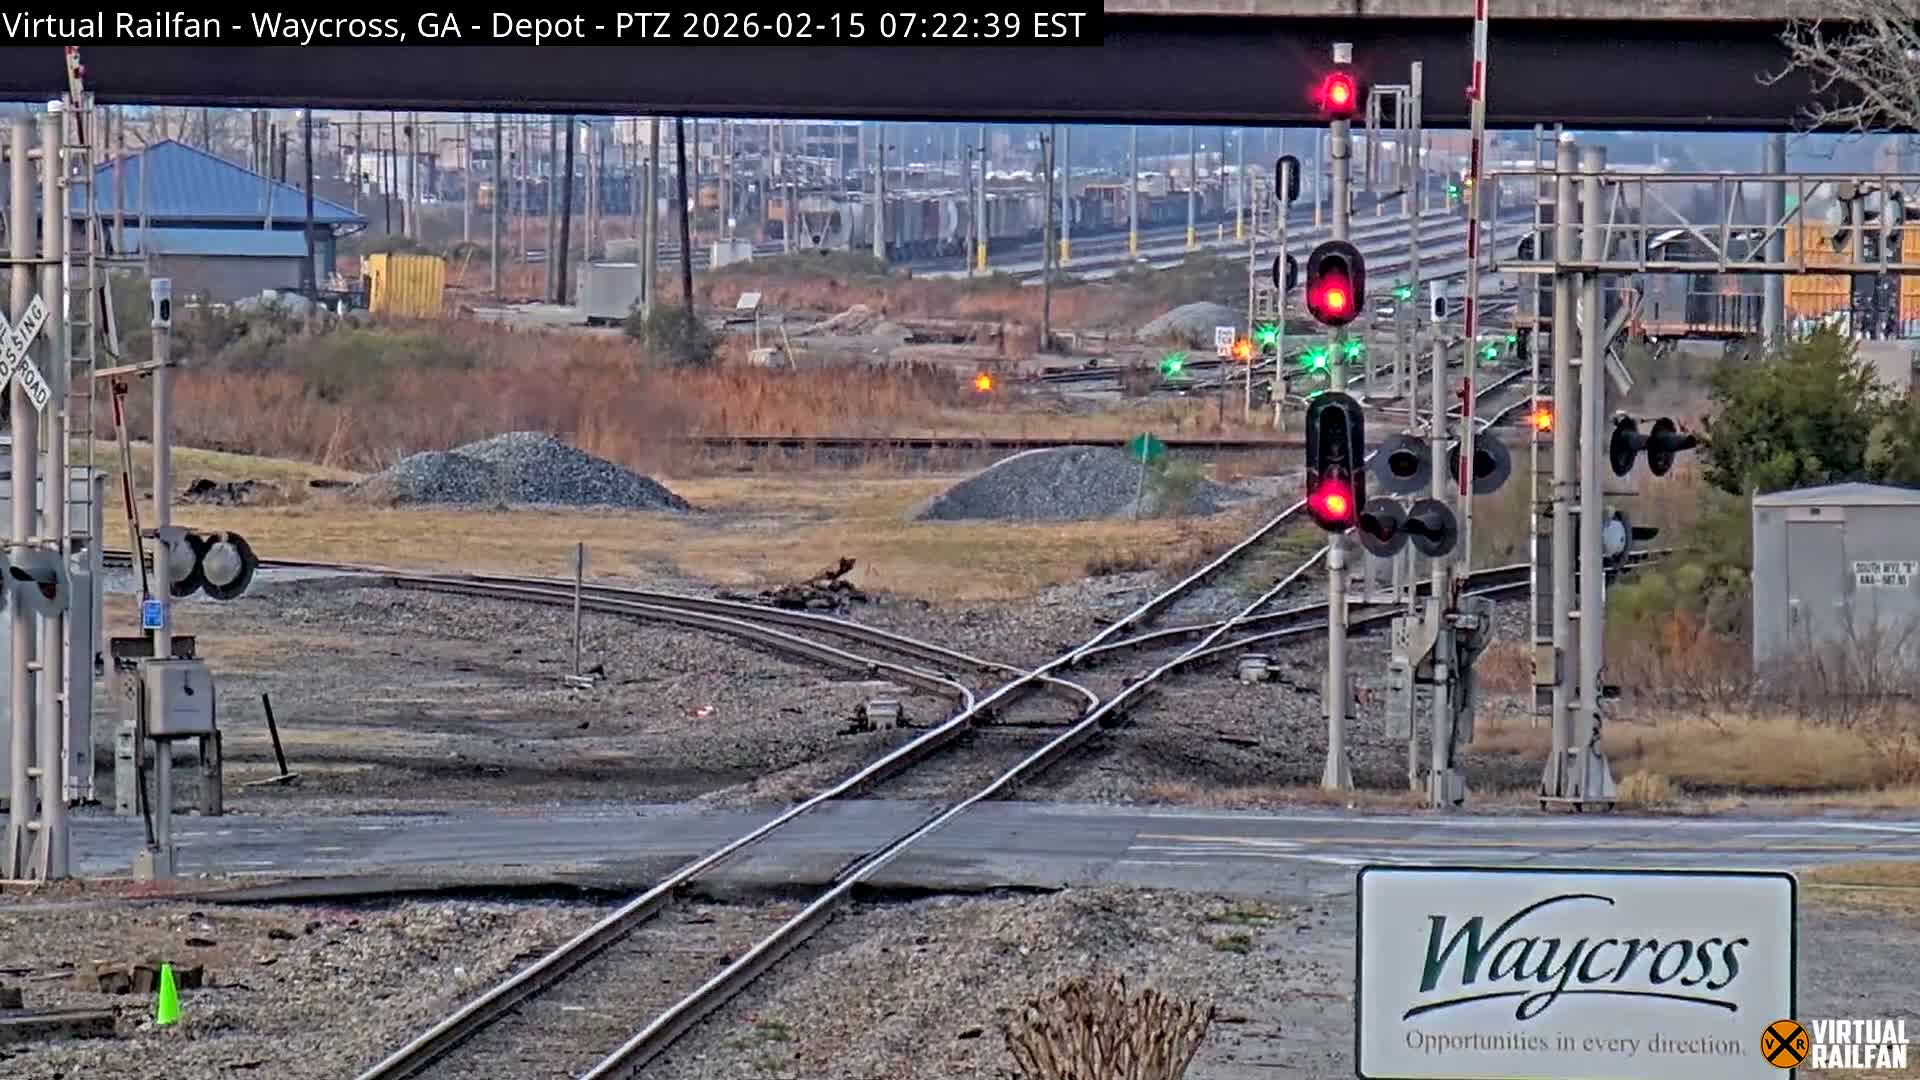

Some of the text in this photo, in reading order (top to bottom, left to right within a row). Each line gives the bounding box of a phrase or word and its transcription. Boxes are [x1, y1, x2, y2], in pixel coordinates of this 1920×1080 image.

[0, 304, 42, 386] OSSING
[20, 359, 47, 404] ROAD
[1419, 893, 1748, 1020] Waycross
[1405, 1029, 1746, 1057] Opportunities in every direction.
